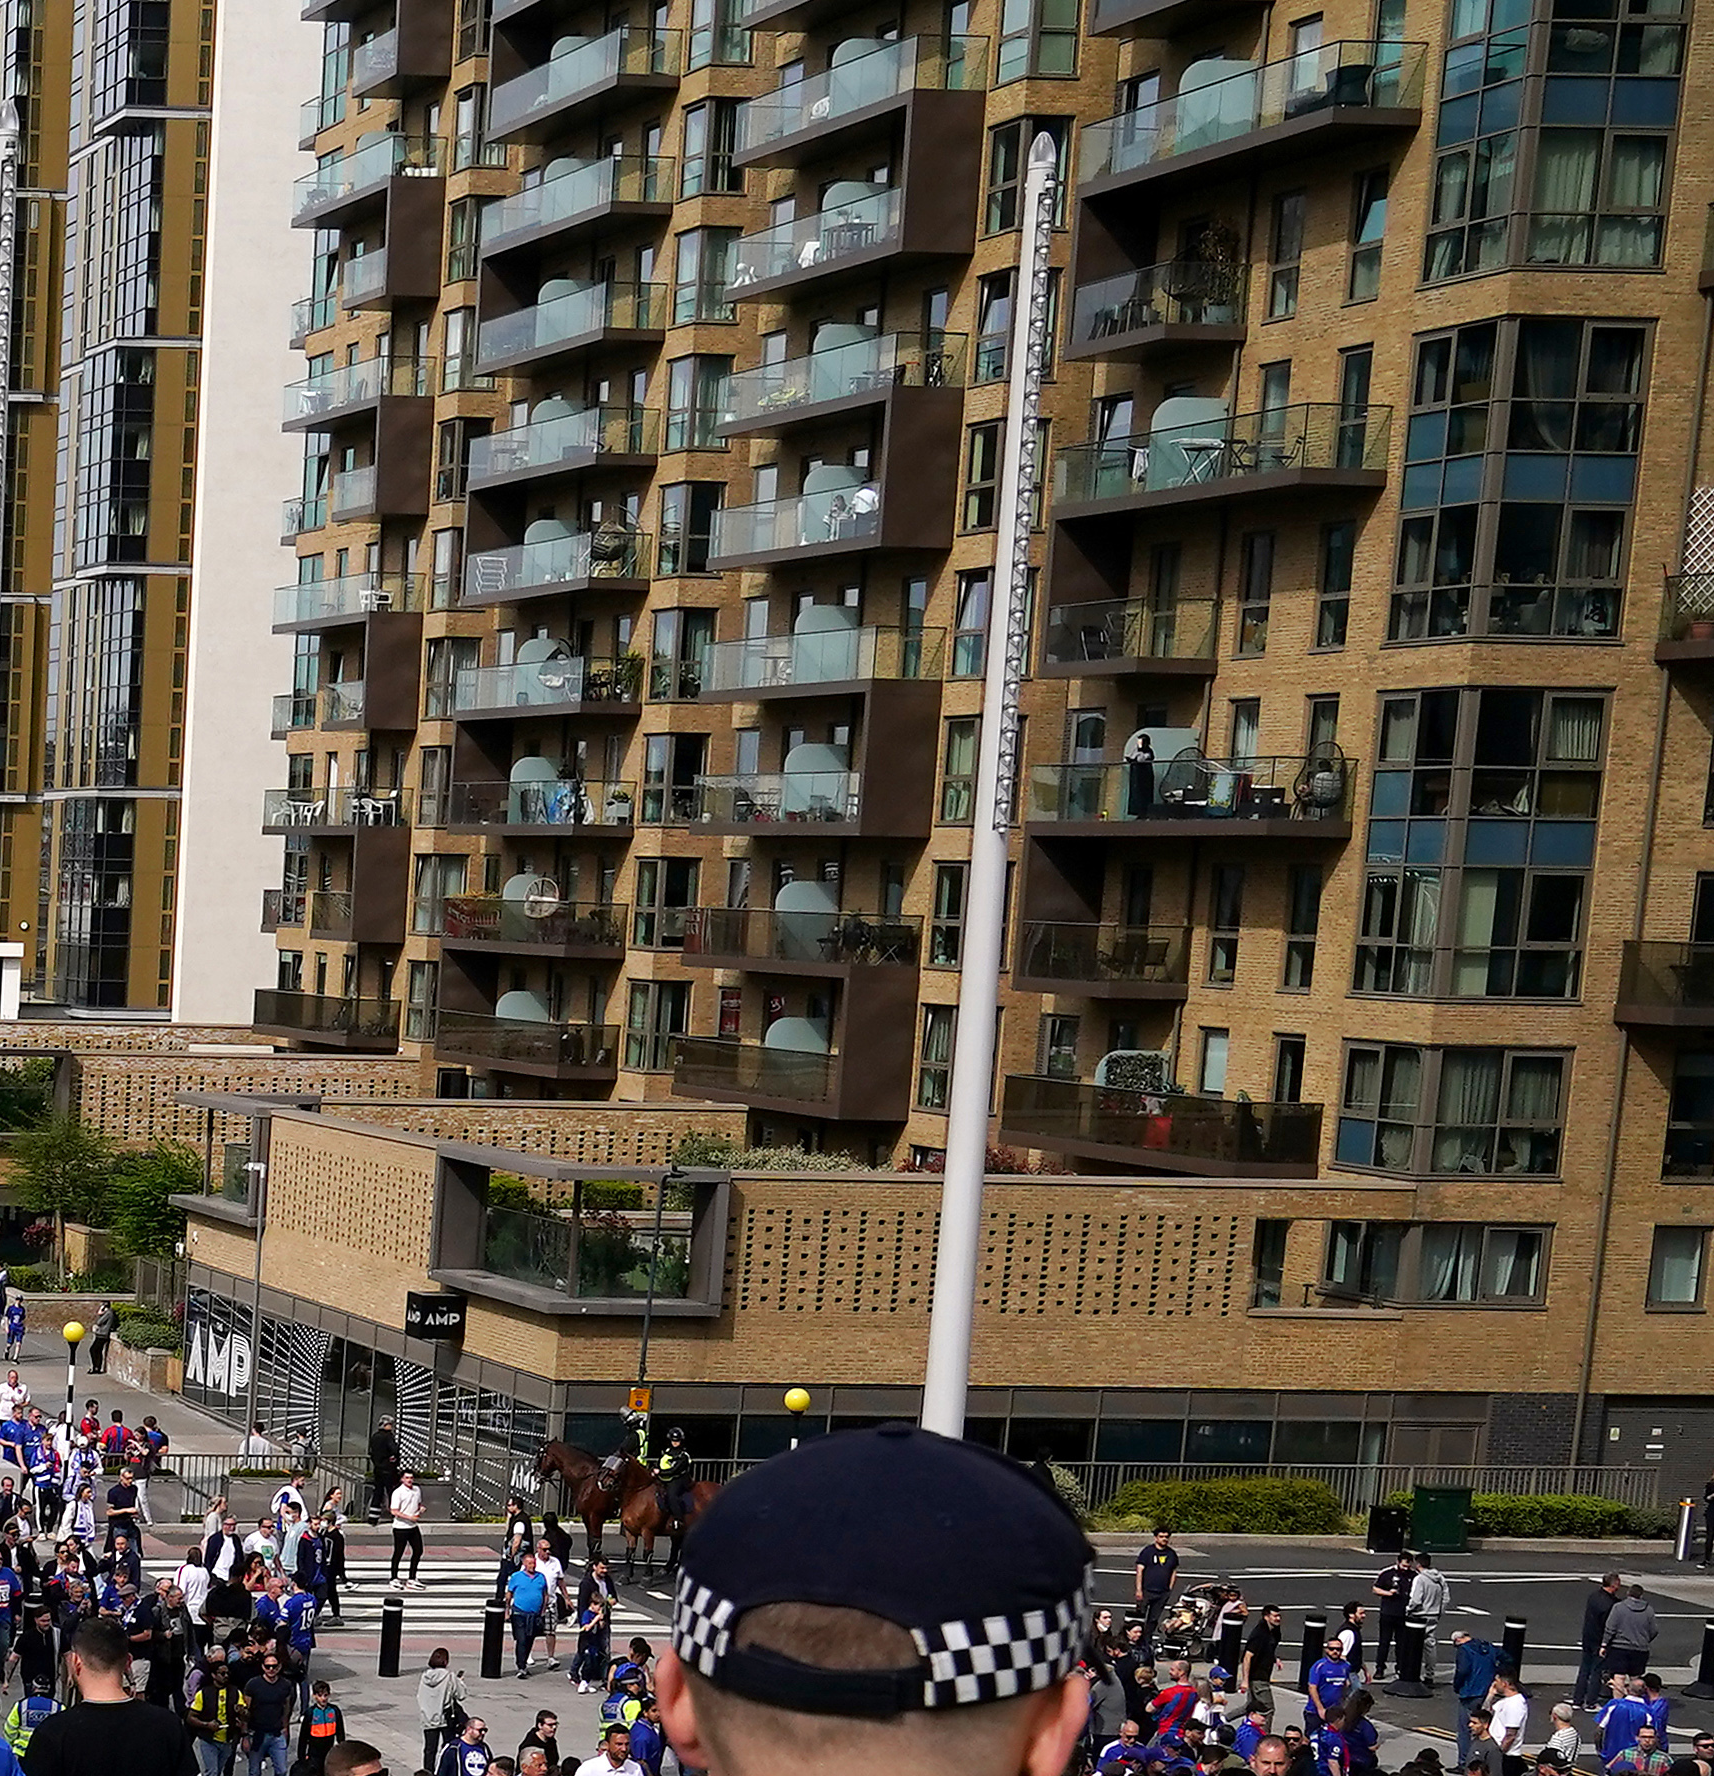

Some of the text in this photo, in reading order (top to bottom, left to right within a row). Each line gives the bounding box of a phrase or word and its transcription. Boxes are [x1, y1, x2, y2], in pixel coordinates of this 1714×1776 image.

[424, 1312, 461, 1326] AMP
[186, 1321, 251, 1398] AMP
[299, 1608, 316, 1631] 19
